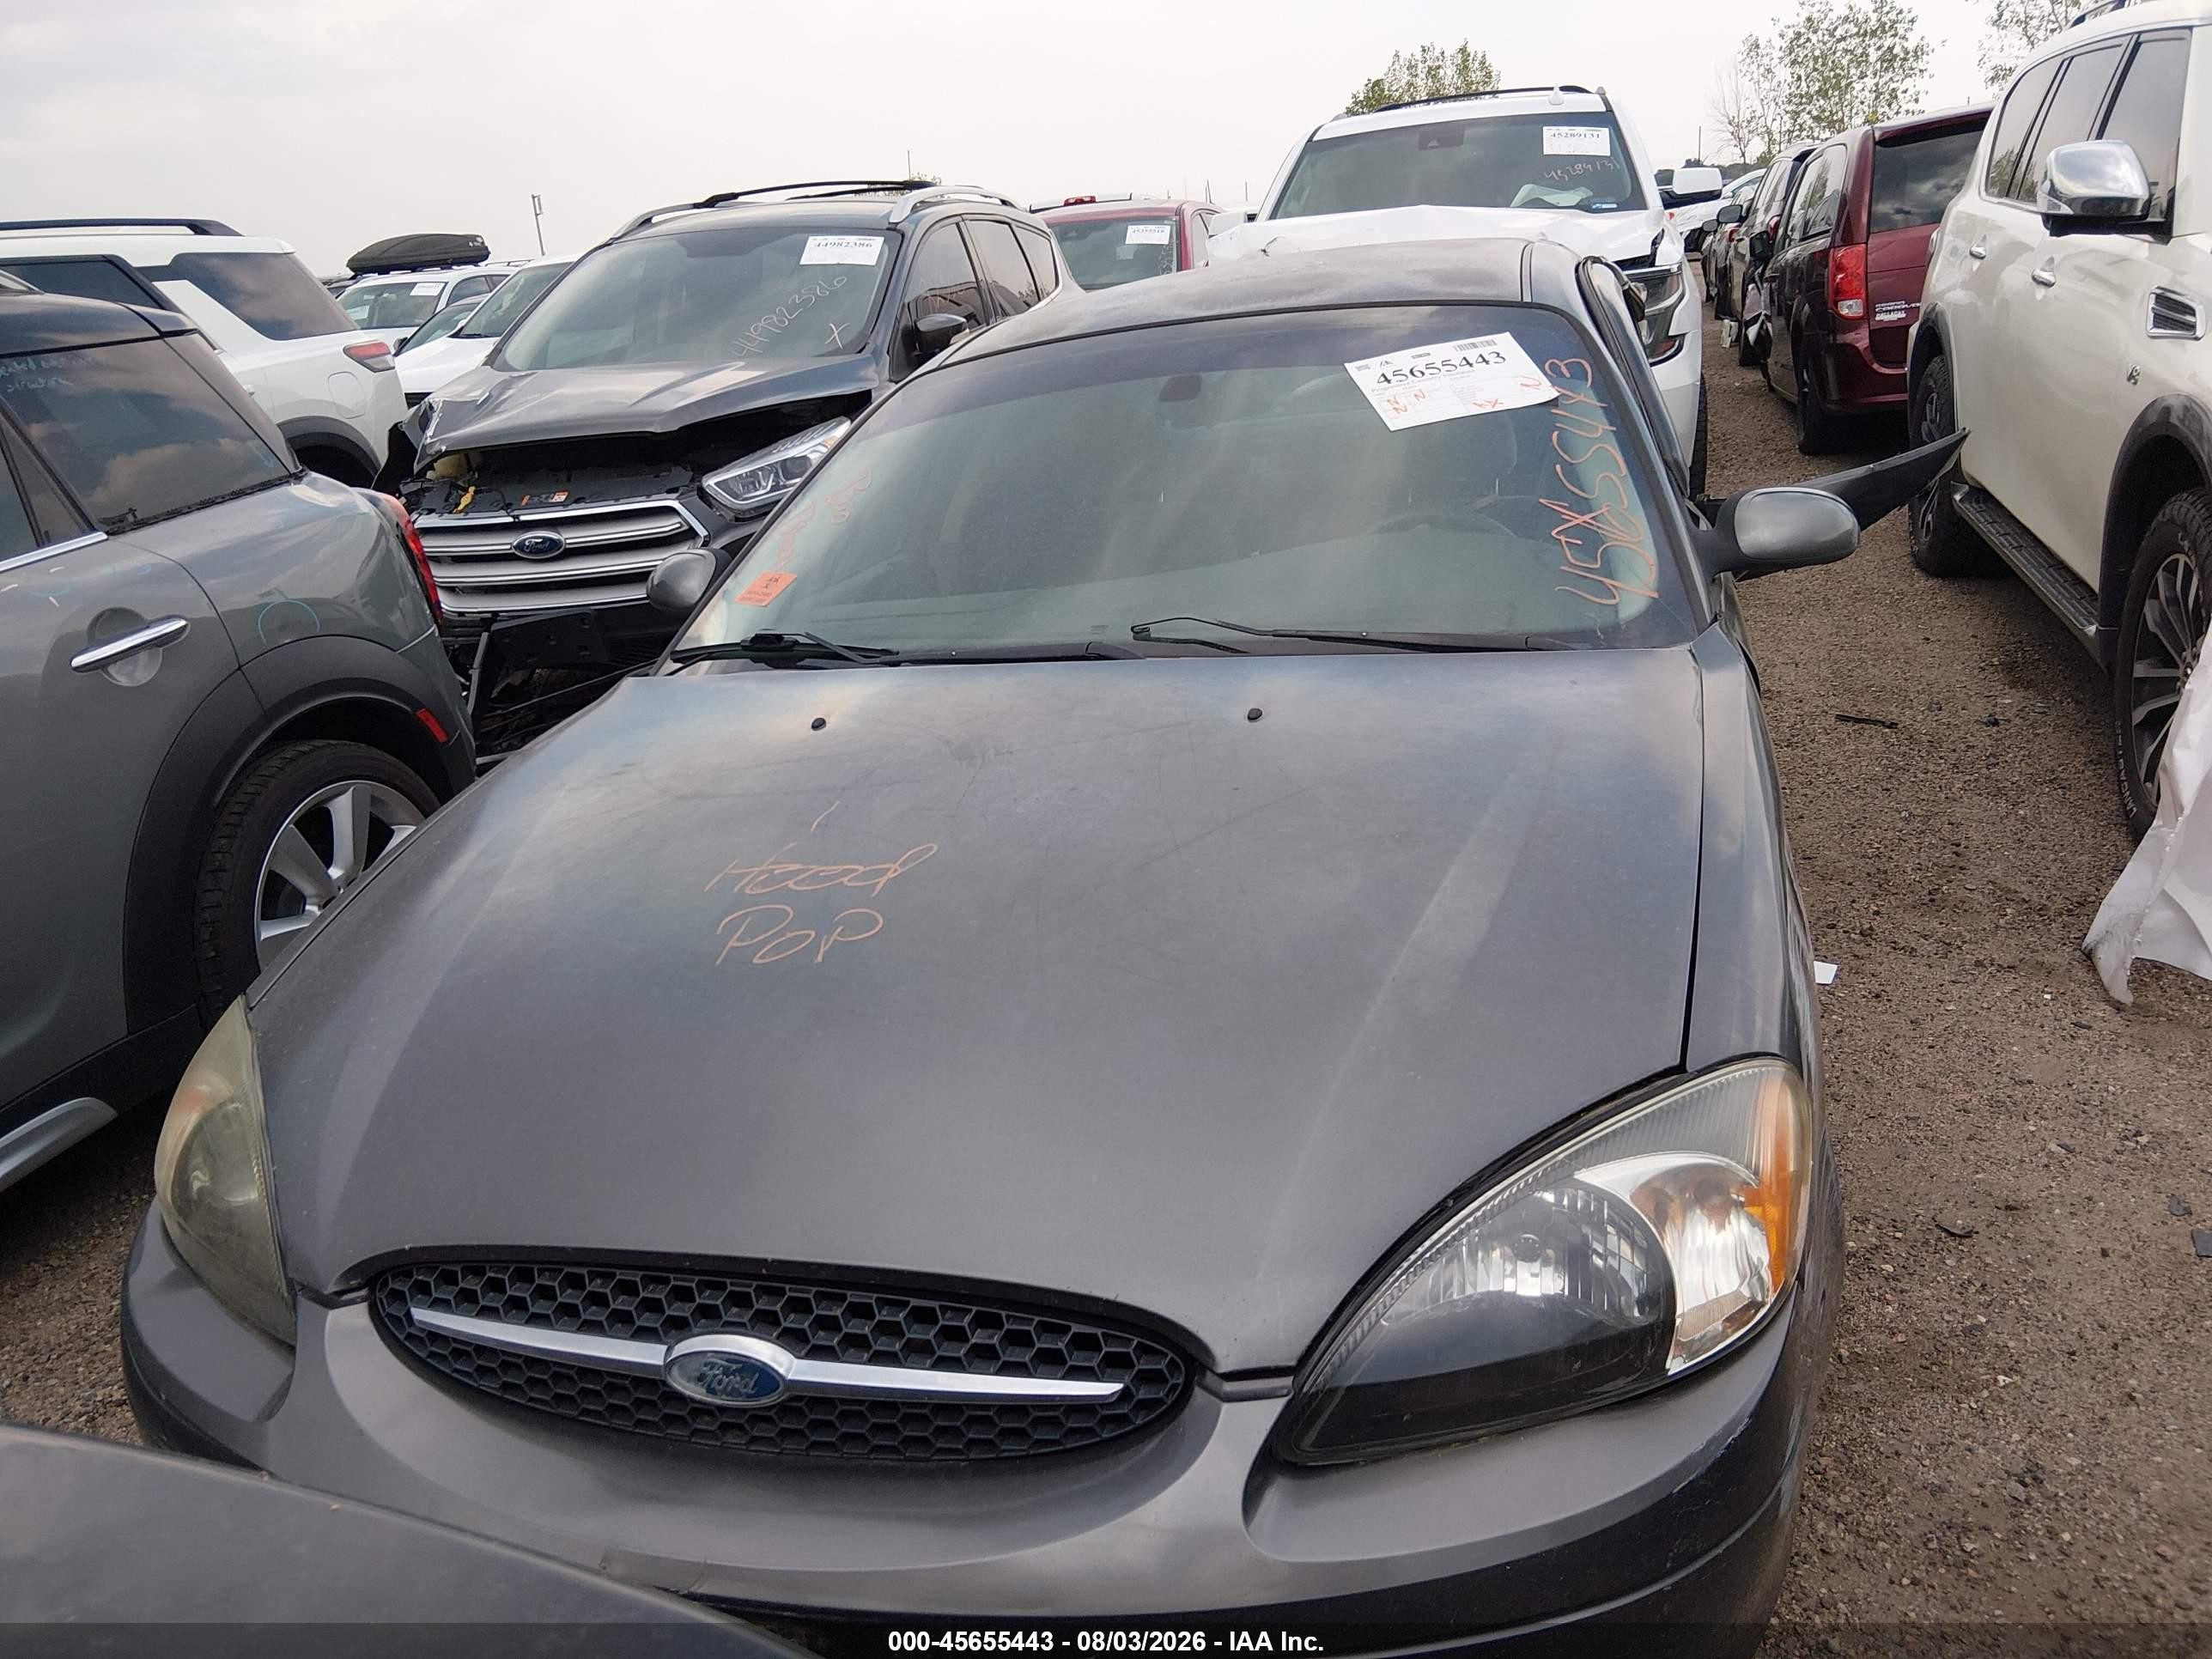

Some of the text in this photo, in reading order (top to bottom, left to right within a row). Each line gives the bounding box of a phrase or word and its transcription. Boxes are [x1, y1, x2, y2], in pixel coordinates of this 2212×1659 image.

[1376, 350, 1507, 386] 45655443
[523, 538, 551, 553] Ford
[696, 1357, 761, 1395] Ford
